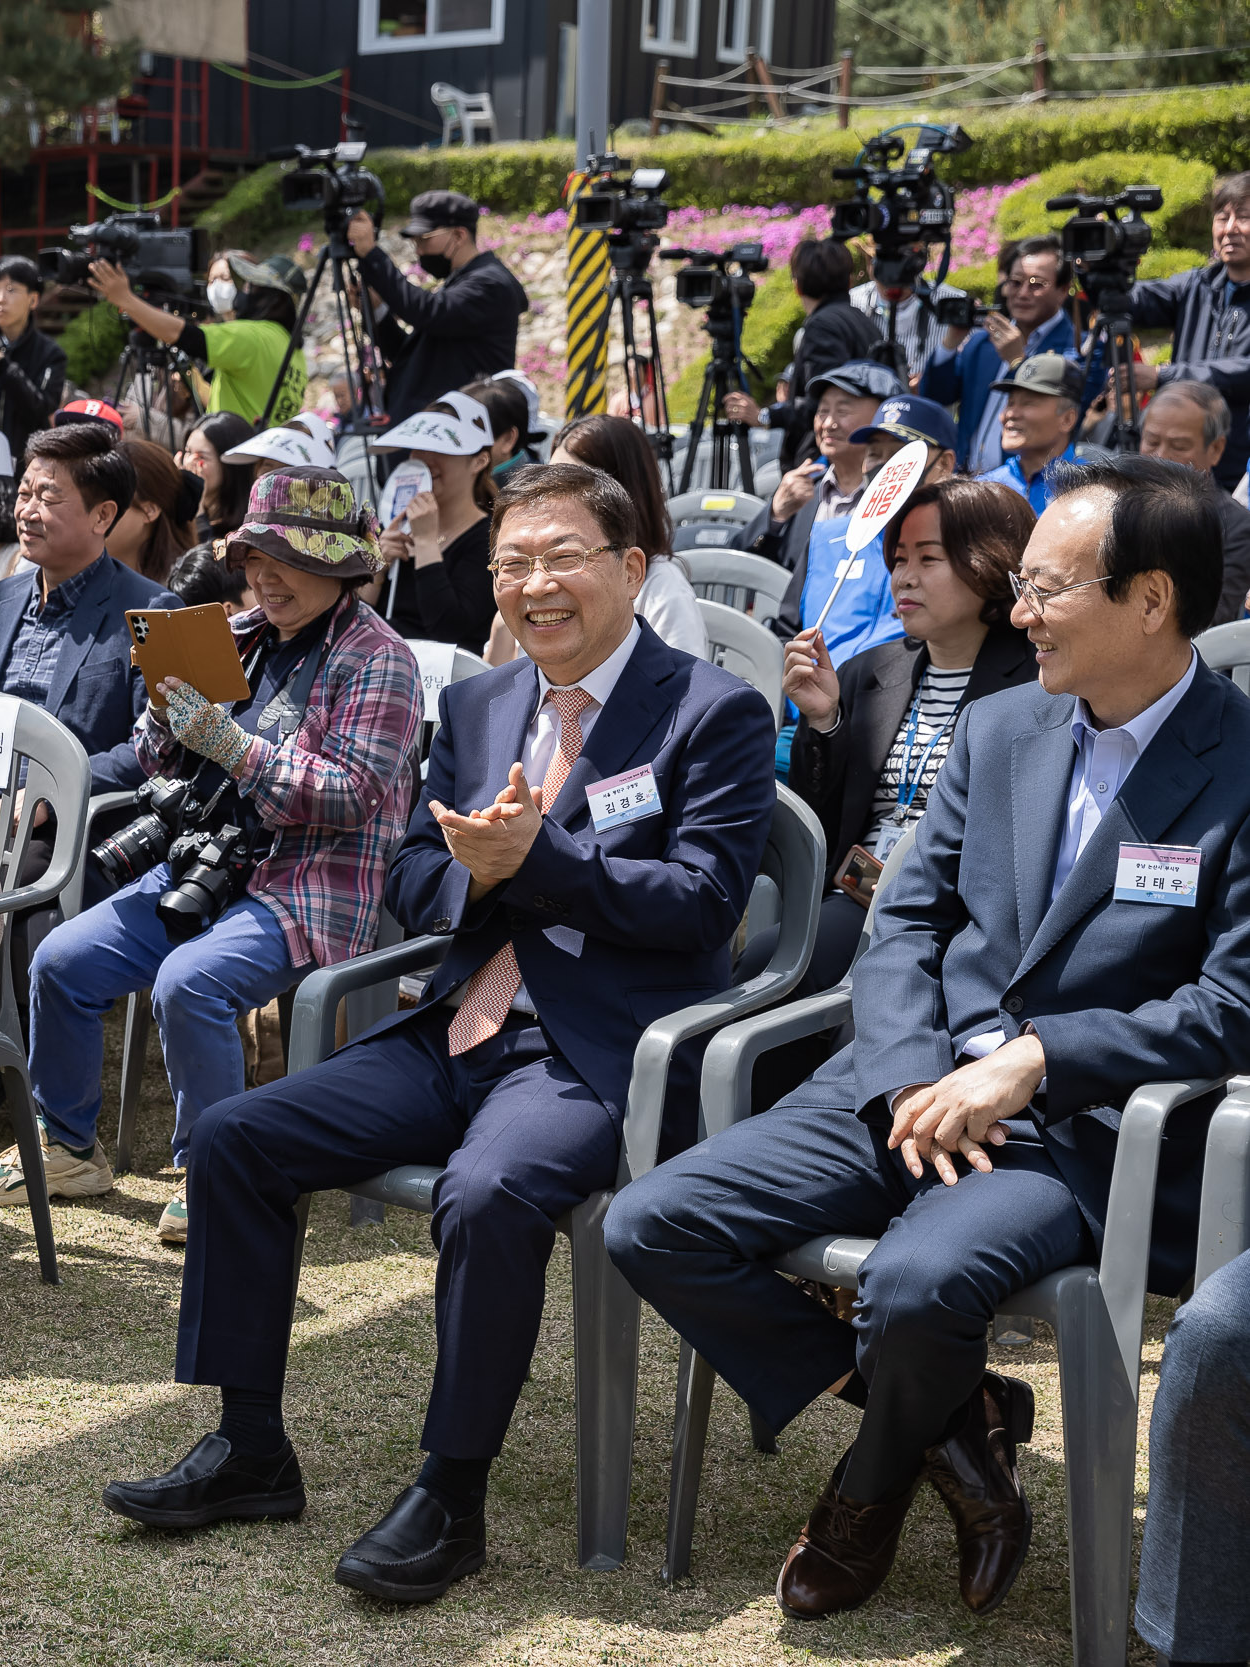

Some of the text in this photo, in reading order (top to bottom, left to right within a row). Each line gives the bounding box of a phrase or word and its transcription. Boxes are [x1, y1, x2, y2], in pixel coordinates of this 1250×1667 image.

[84, 400, 101, 416] B
[879, 460, 918, 487] 잘되길
[862, 482, 904, 519] 바람
[605, 792, 646, 815] 김경호
[1135, 875, 1183, 892] 김태우
